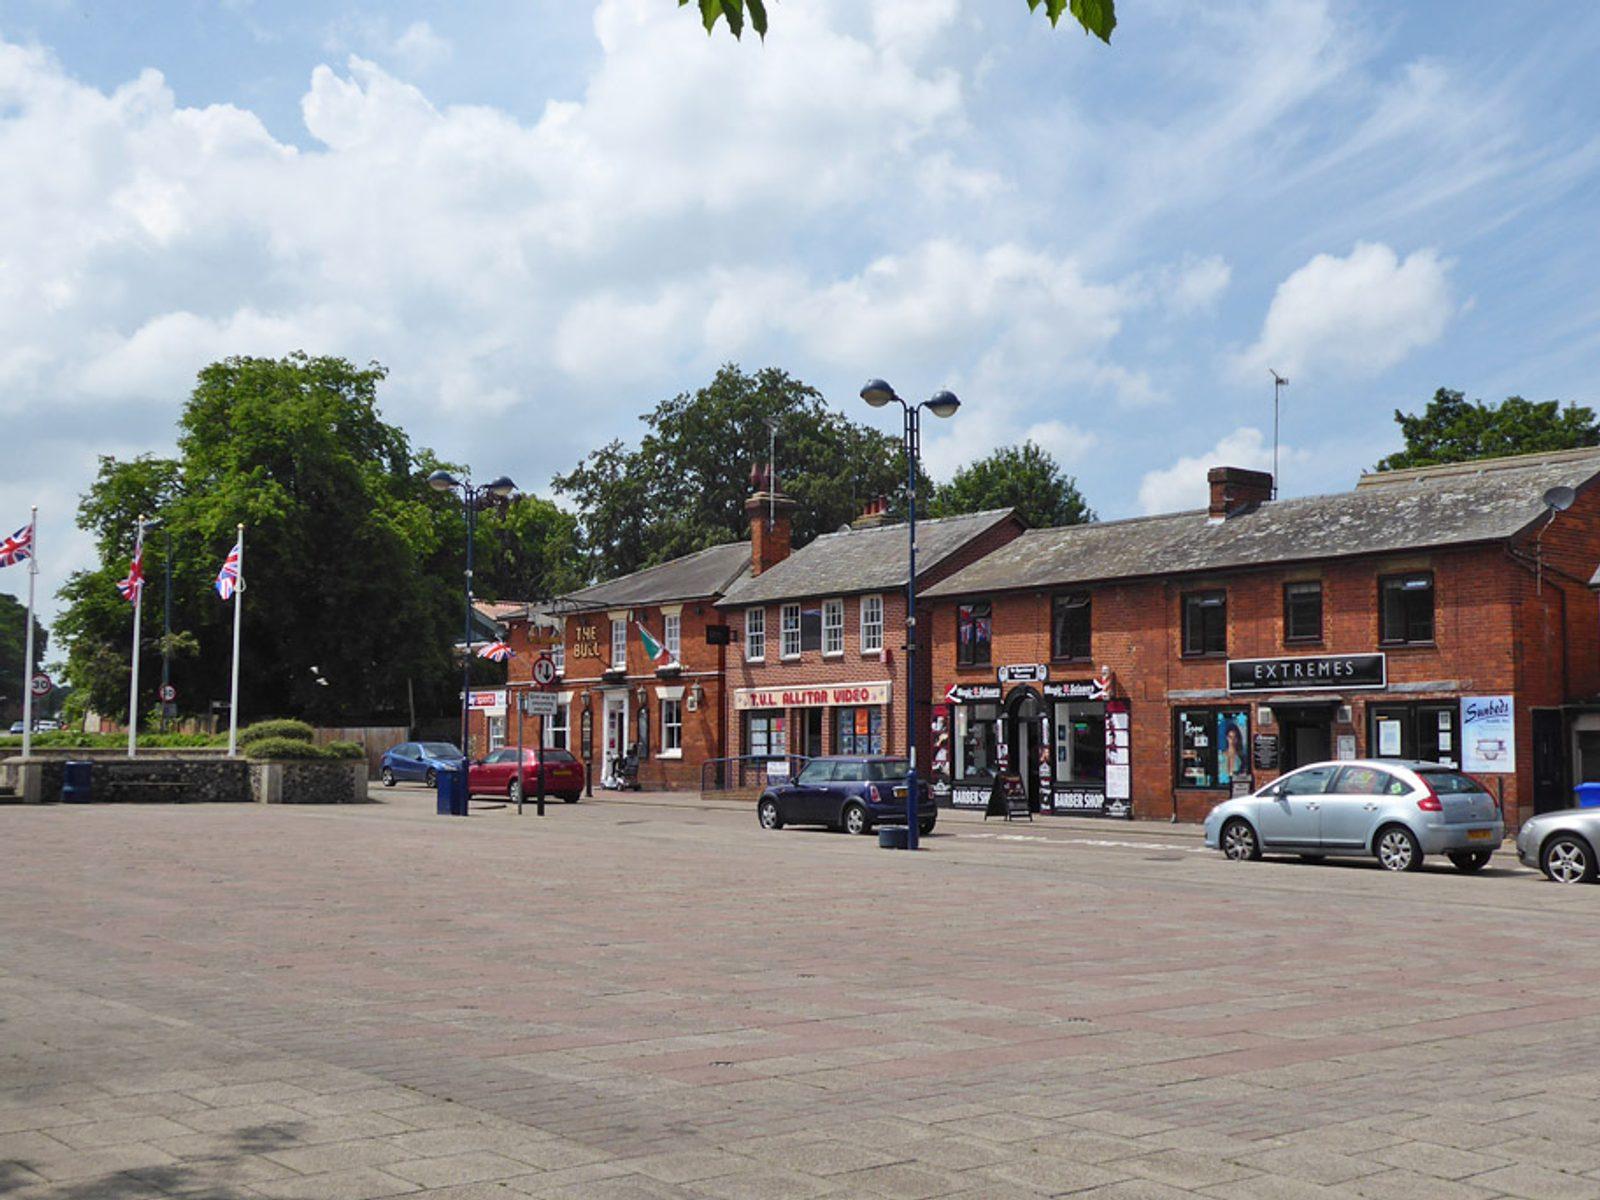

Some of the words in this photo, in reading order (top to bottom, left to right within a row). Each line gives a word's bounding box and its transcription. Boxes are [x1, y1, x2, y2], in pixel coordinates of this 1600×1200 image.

[576, 626, 597, 641] THE
[573, 642, 600, 658] BULL
[1254, 661, 1354, 679] EXTREMES
[782, 690, 828, 705] ALLSTAR
[833, 688, 869, 703] VIDEO
[1464, 699, 1509, 724] Sunbeds
[953, 790, 977, 805] BARBER
[1054, 793, 1083, 808] BARBER
[1084, 794, 1105, 808] SHOP
